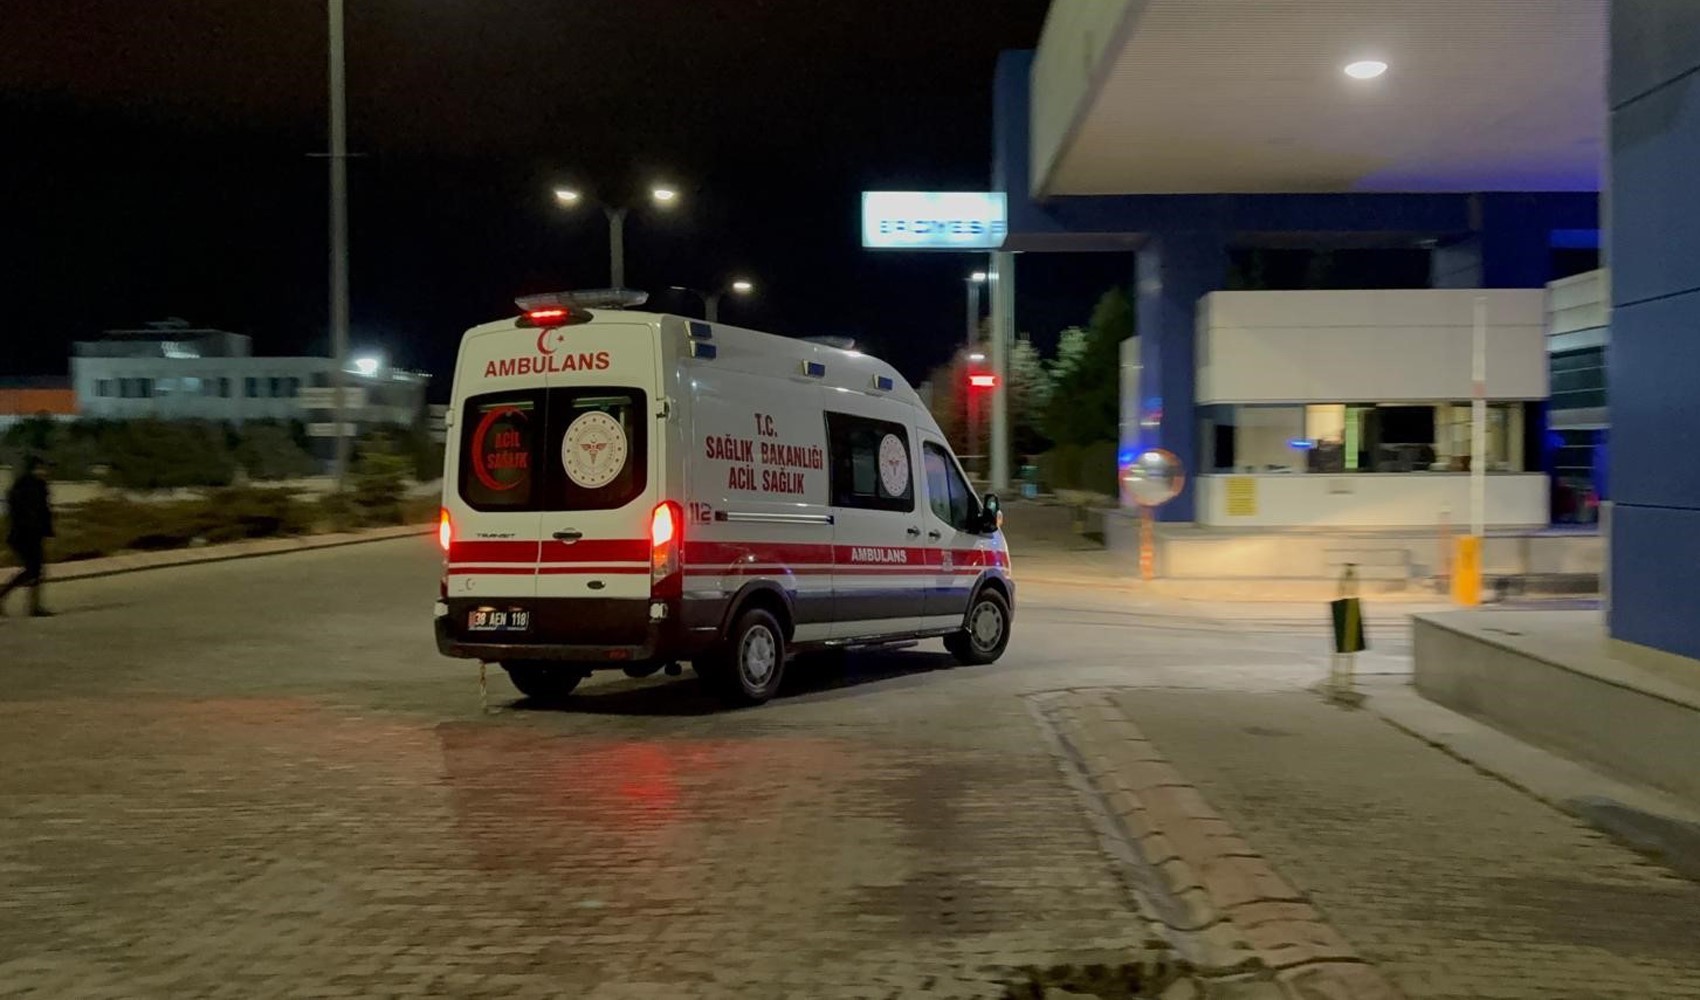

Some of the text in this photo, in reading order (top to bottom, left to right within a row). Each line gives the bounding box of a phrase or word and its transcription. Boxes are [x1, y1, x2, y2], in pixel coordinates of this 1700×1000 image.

[484, 351, 610, 378] AMBULANS
[754, 412, 778, 438] T.C.
[705, 433, 823, 471] SAĞLIK BAKANLIĞI
[728, 464, 805, 495] ACİL SAĞLIK
[689, 501, 713, 523] 112
[851, 547, 907, 563] AMBULANS
[512, 611, 527, 626] 118
